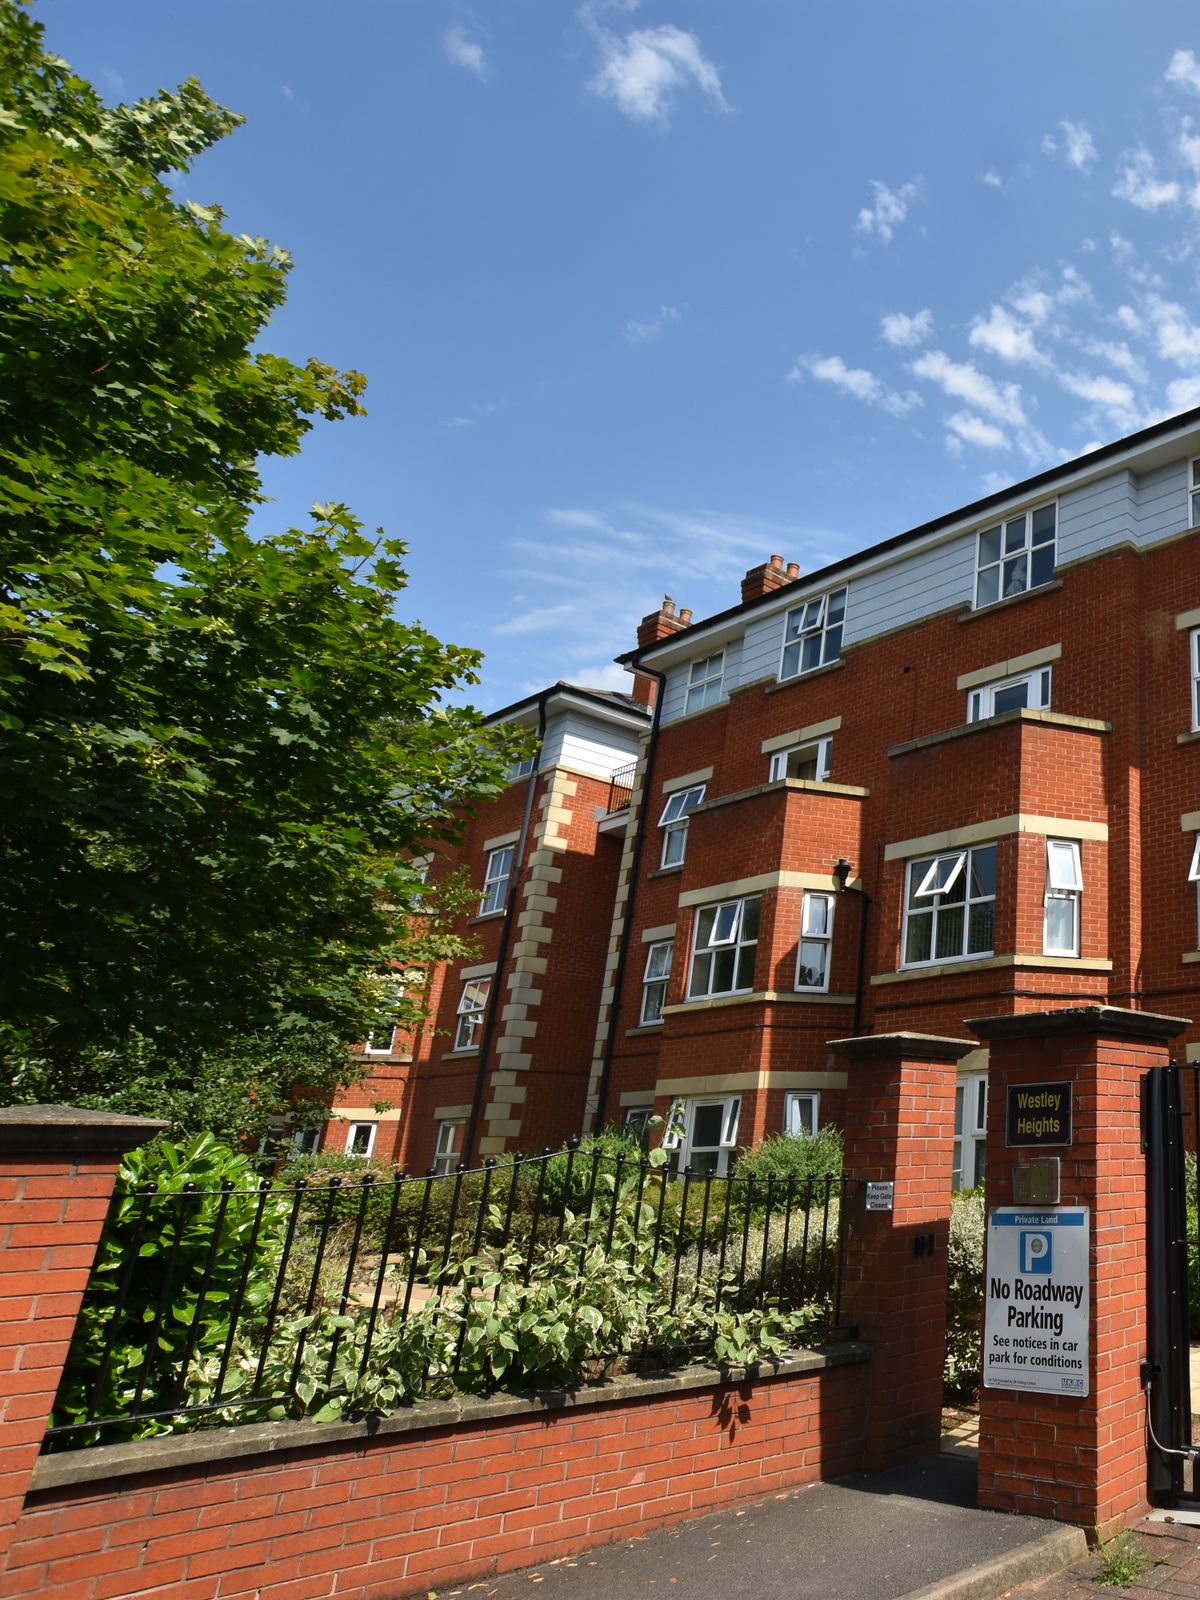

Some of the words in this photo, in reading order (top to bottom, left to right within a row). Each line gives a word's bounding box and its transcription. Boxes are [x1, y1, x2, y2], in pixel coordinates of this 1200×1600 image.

[1017, 1091, 1061, 1111] Westley
[1017, 1116, 1060, 1137] Heights
[867, 1192, 880, 1200] Keep
[1014, 1215, 1040, 1224] Private
[1041, 1215, 1058, 1224] Land
[1025, 1233, 1048, 1271] P
[991, 1278, 1010, 1300] No
[1014, 1278, 1083, 1309] Roadway
[1007, 1305, 1063, 1336] Parking
[993, 1335, 1010, 1347] See
[1012, 1336, 1047, 1350] notices
[1050, 1338, 1059, 1350] in
[1062, 1341, 1078, 1351] car
[989, 1351, 1010, 1365] park
[1013, 1352, 1027, 1365] for
[1030, 1355, 1082, 1369] conditions
